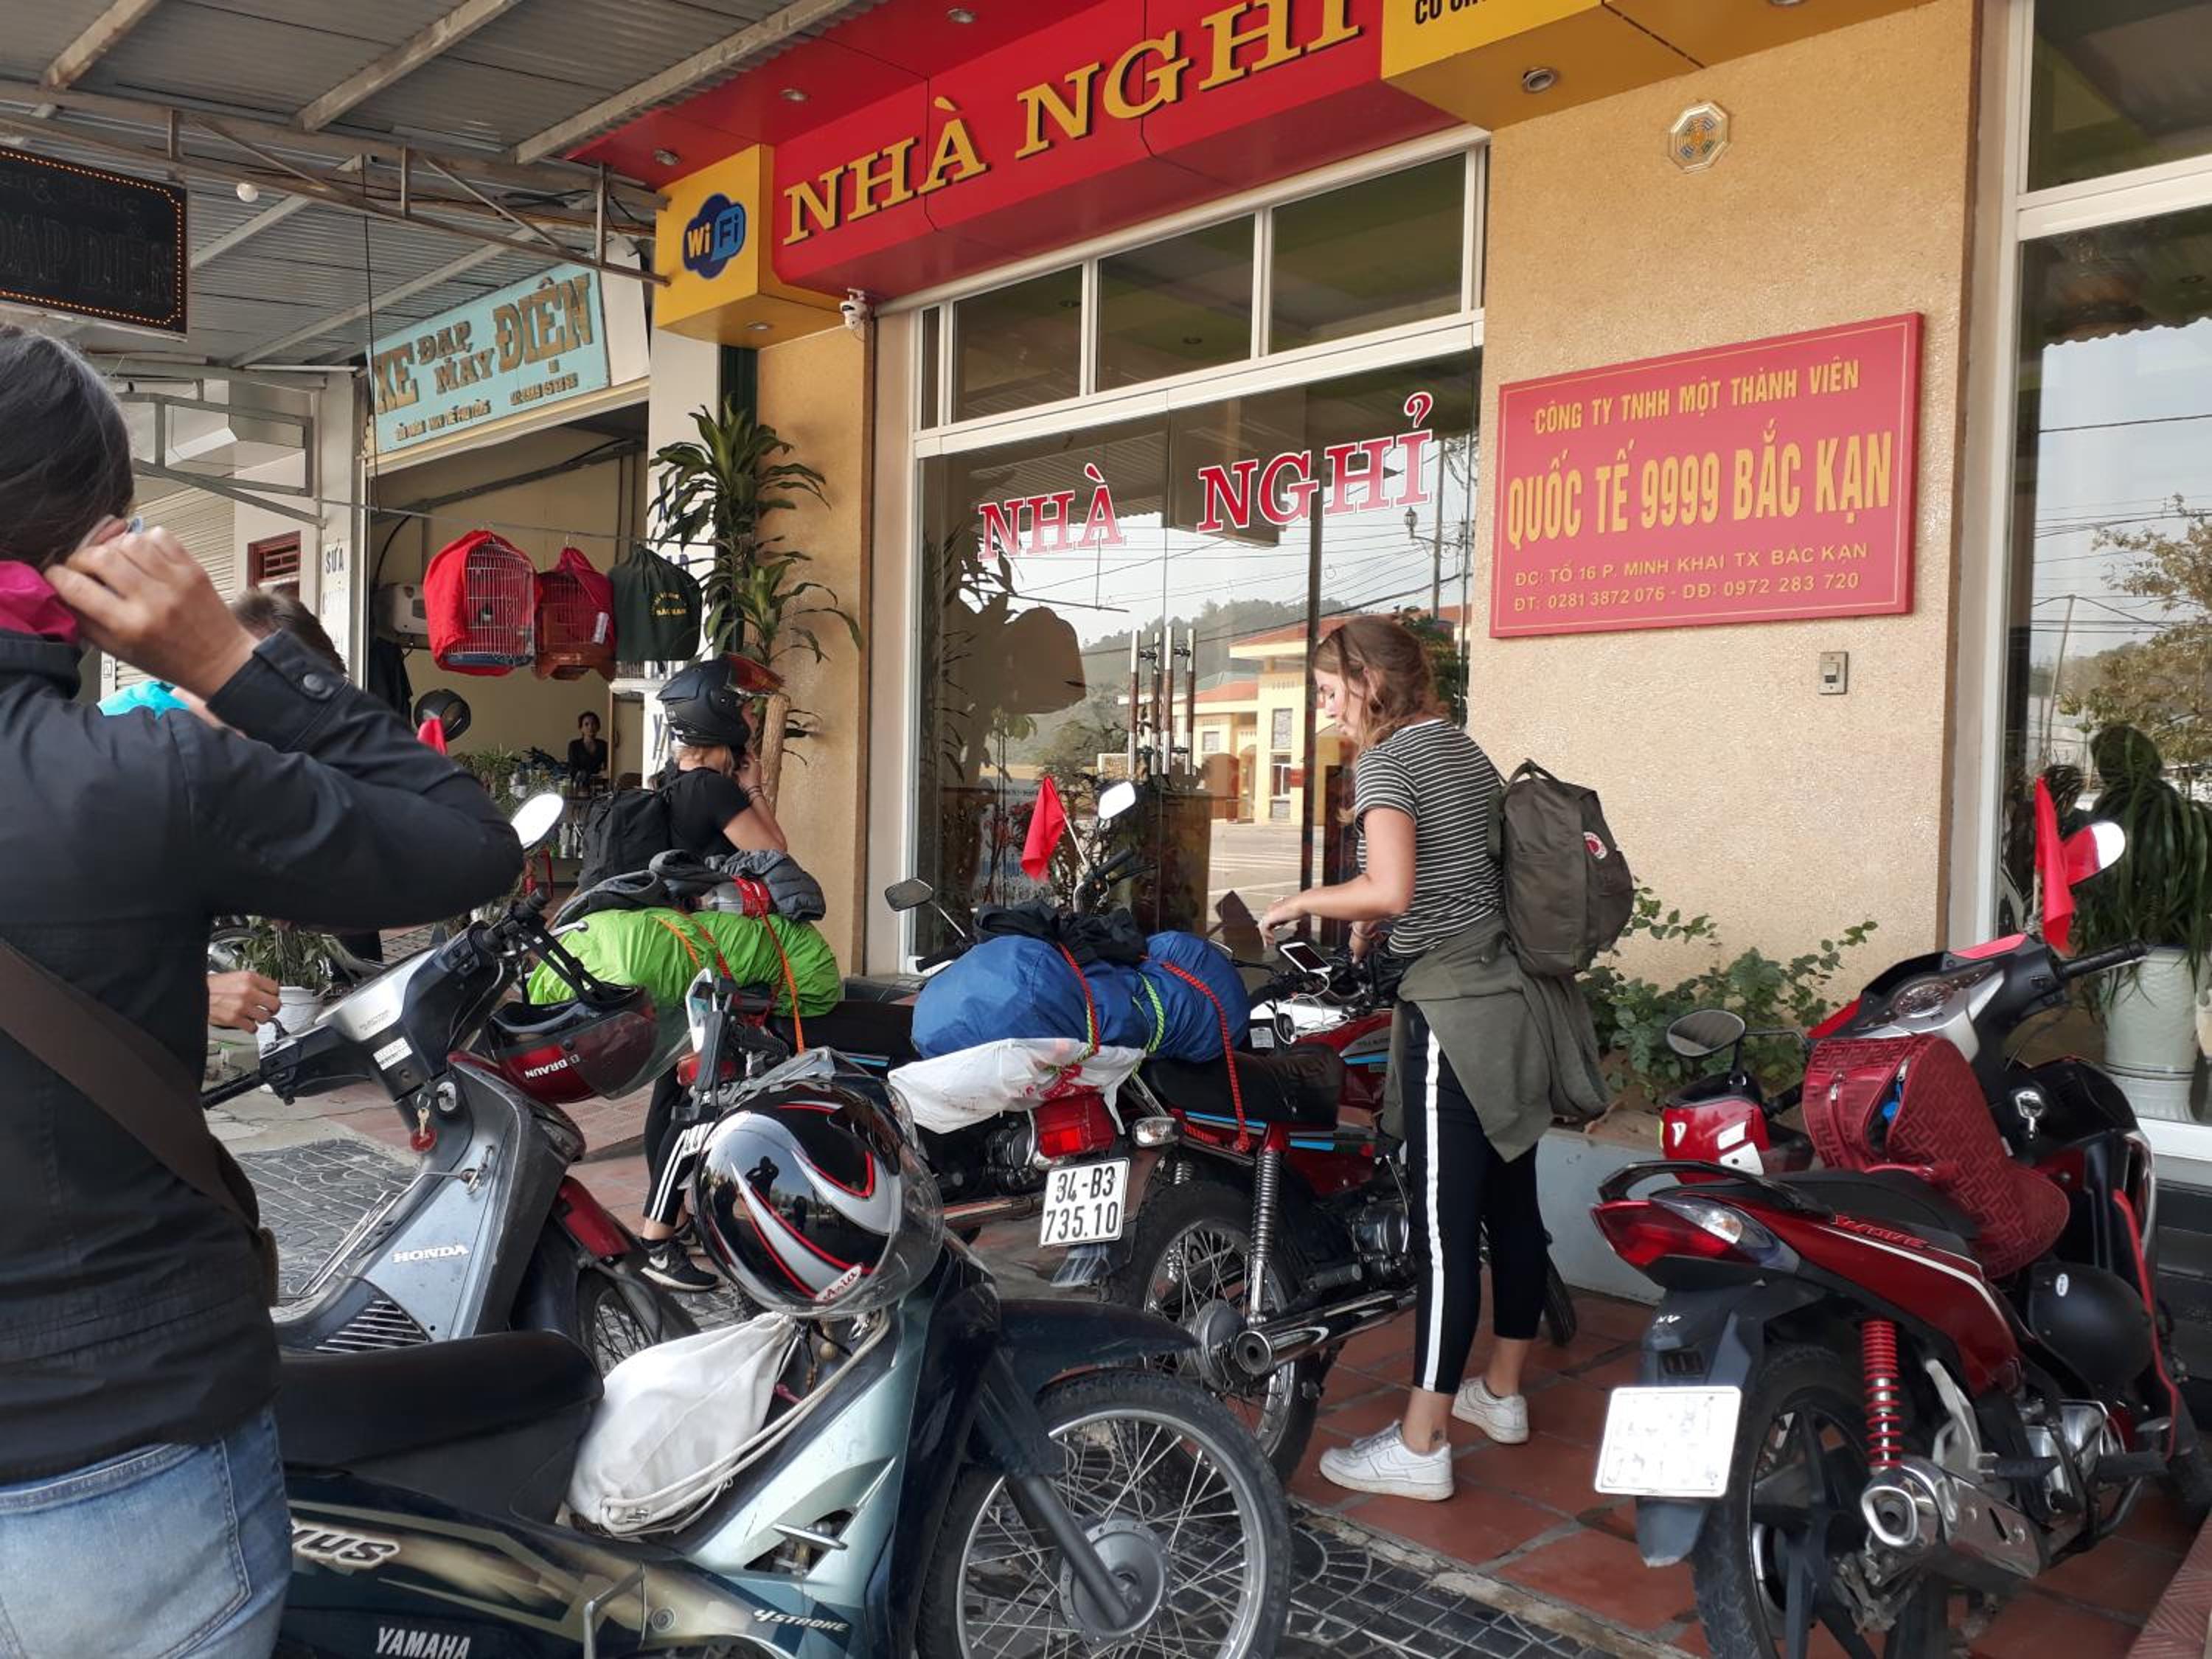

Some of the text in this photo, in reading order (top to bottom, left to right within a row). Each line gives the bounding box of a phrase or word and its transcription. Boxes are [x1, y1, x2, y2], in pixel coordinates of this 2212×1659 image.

[783, 97, 990, 246] NHÀ
[373, 342, 419, 414] XE
[493, 276, 594, 375] ĐIỆN
[1534, 356, 1860, 435] CÔNG TY TNHH MỘT THÀNH VIÊN
[978, 391, 1433, 562] NHÀ NGHỈ
[1508, 419, 1893, 551] QUỐC TẾ 9999 BẮC KẠN
[1580, 566, 1596, 580] 16
[1624, 559, 1669, 576] MINH
[1677, 554, 1725, 573] KHAI
[1734, 552, 1759, 567] TX
[1723, 578, 1770, 597] 0972
[1778, 574, 1815, 593] 283
[1824, 571, 1860, 589] 720
[1055, 1165, 1115, 1203] 34-B3
[1044, 1200, 1119, 1242] 735.10
[392, 1244, 470, 1264] HONDA
[376, 1627, 471, 1659] YAMAHA
